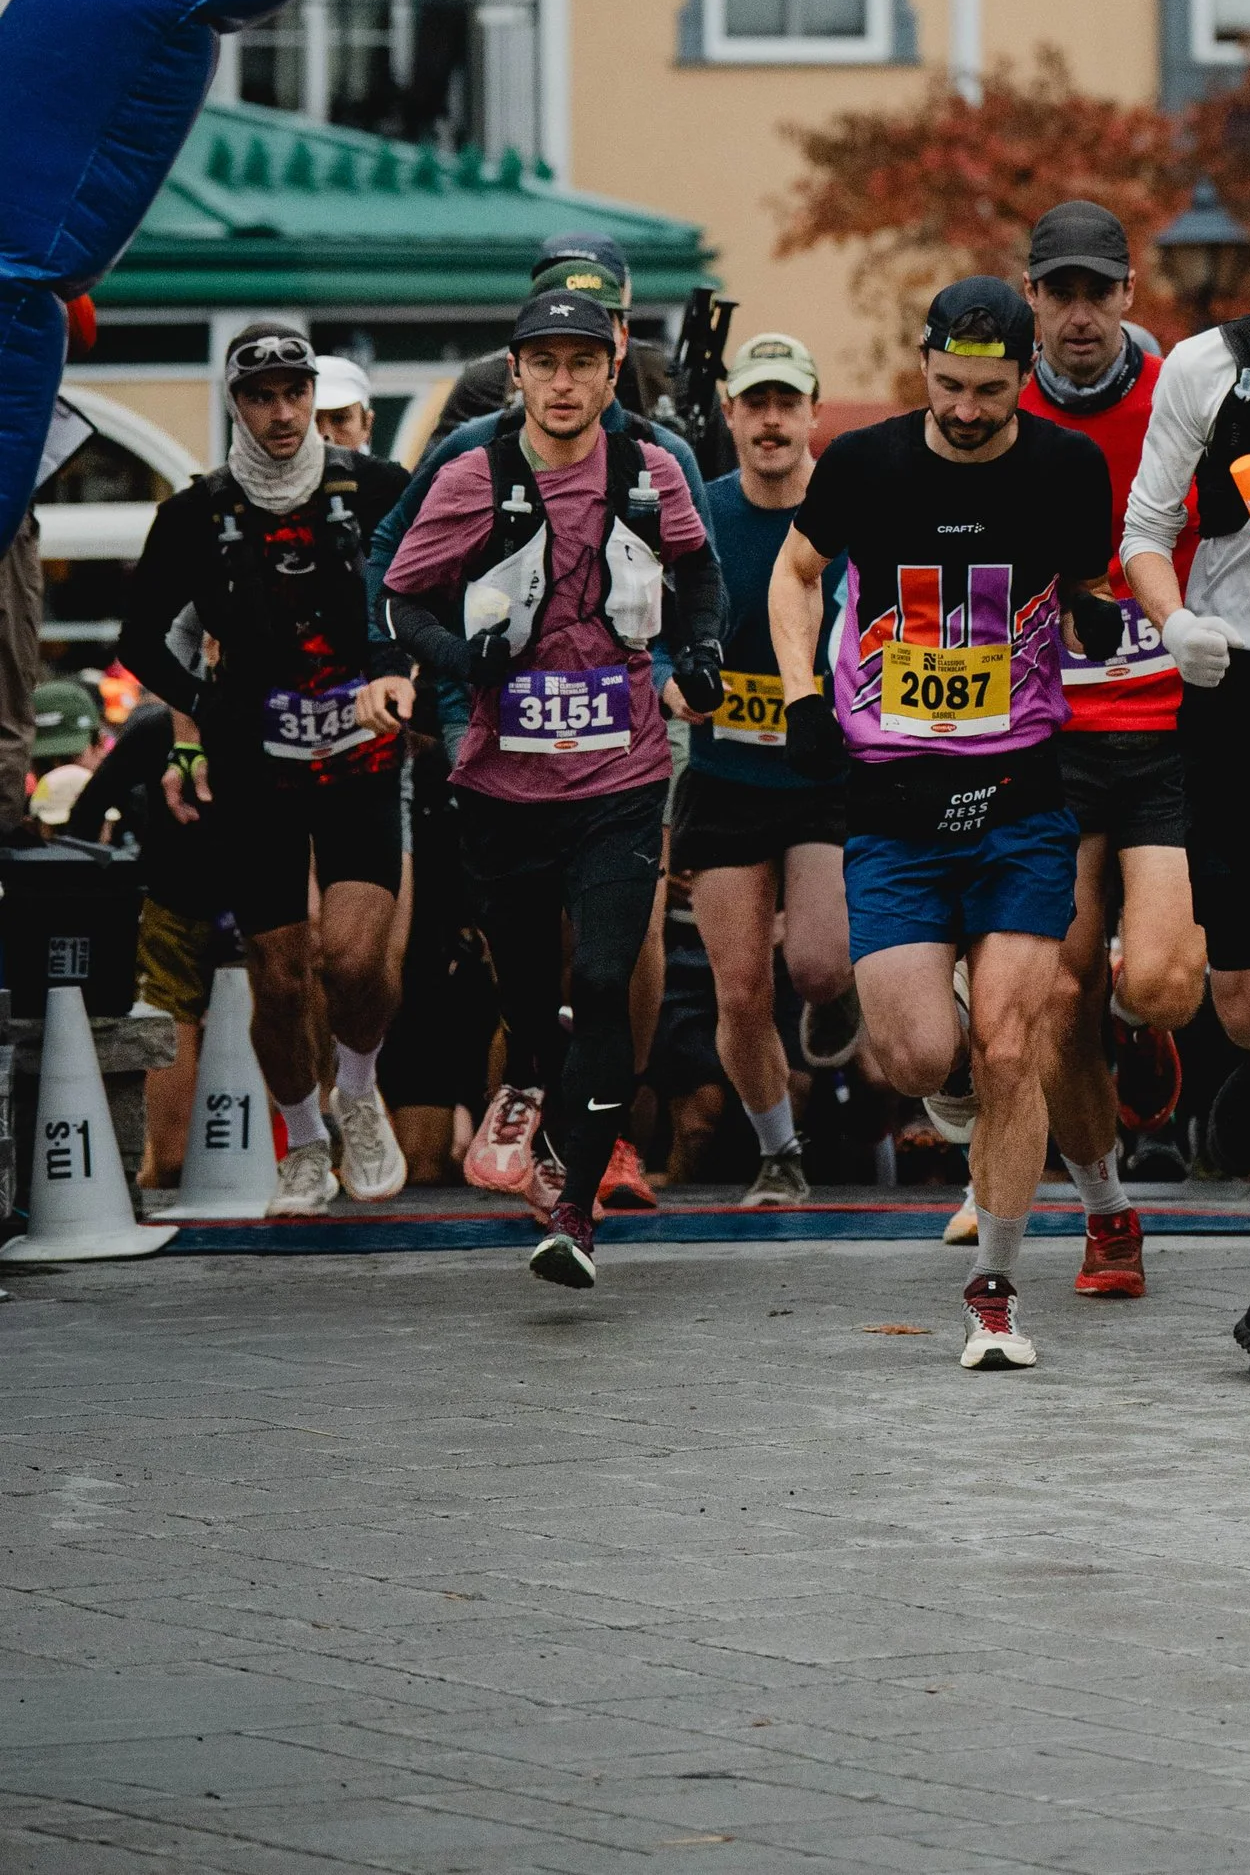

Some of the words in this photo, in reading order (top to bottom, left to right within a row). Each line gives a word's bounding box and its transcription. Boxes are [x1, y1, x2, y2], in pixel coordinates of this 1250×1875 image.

[937, 524, 974, 533] CRAFT
[900, 671, 991, 710] 2087
[518, 693, 614, 730] 3151
[727, 694, 785, 724] 207
[931, 712, 956, 720] GABRIEL
[279, 703, 357, 742] 3149
[950, 785, 997, 805] COMP
[944, 802, 988, 819] RESS
[937, 816, 985, 832] PORT
